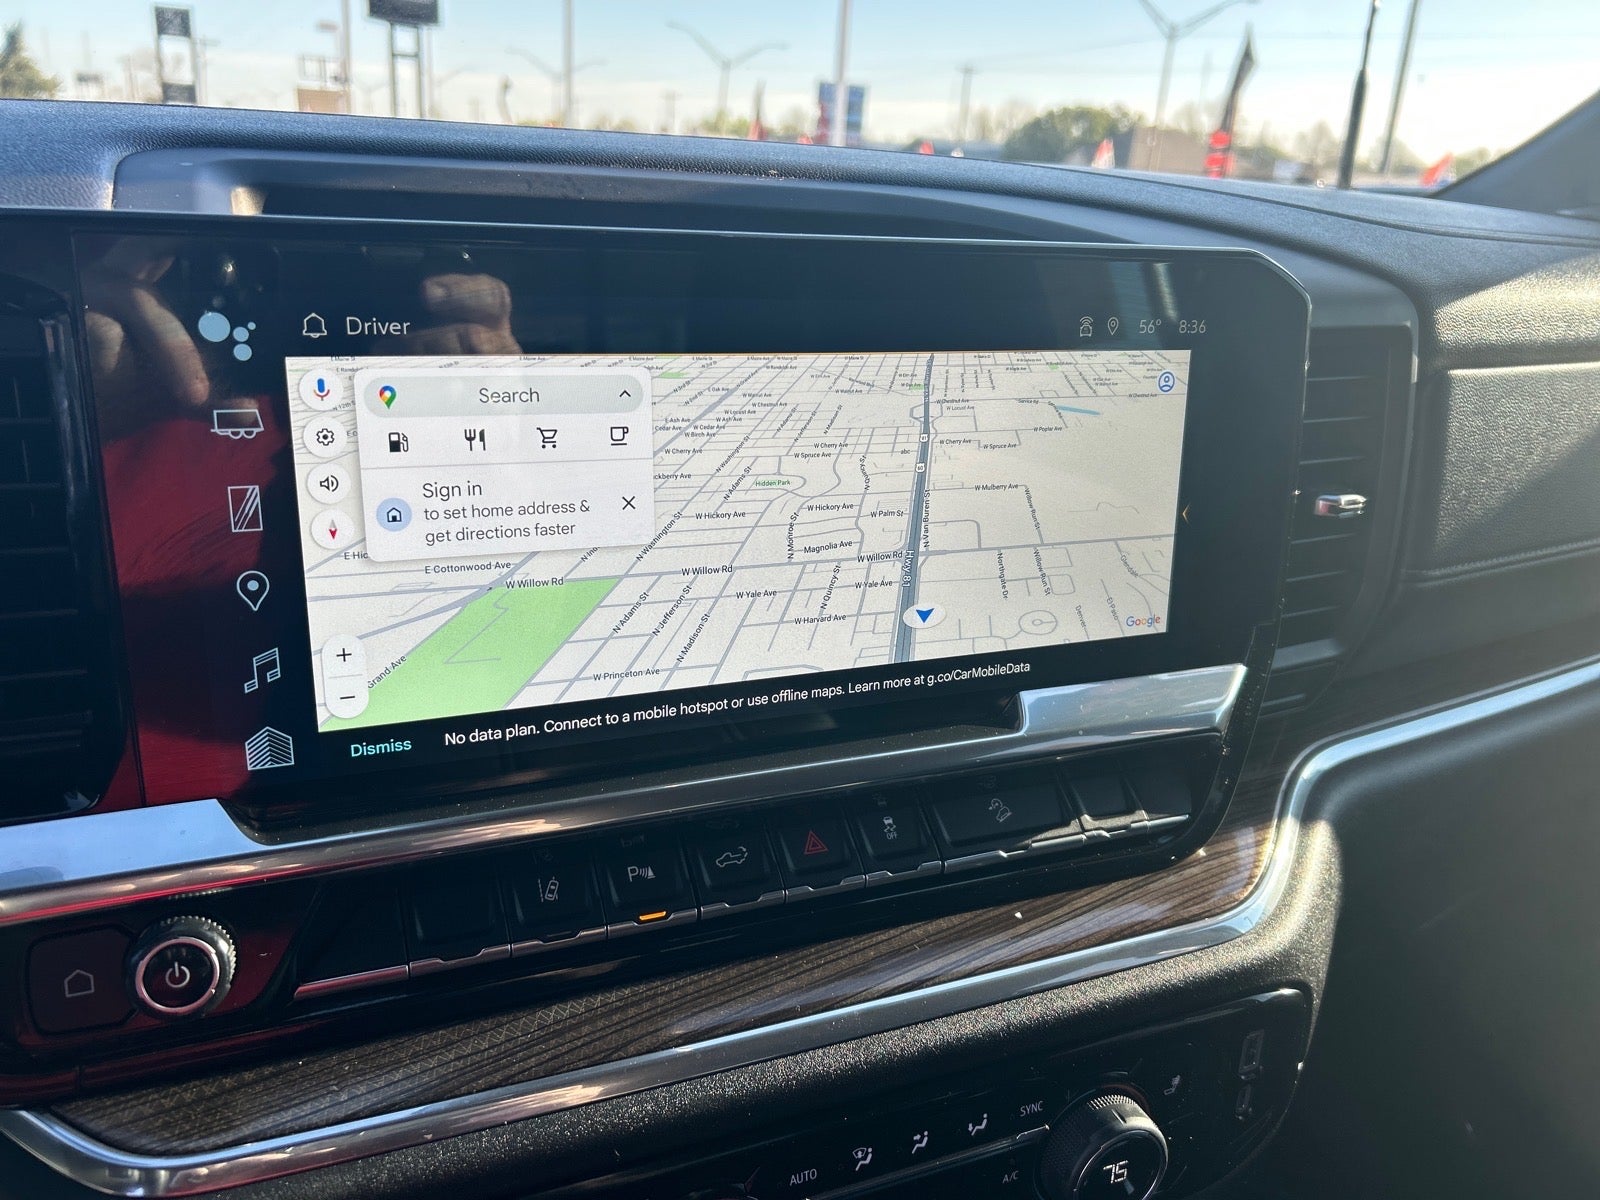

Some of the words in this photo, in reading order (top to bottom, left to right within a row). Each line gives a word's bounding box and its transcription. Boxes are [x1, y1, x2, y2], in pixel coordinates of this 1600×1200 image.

[346, 316, 411, 336] Driver
[1139, 318, 1162, 334] 56°
[1178, 320, 1206, 334] 8:36
[479, 387, 540, 404] Search
[719, 440, 746, 470] Washington
[728, 473, 746, 495] Adams
[744, 466, 752, 475] St
[860, 463, 871, 485] Quincy
[422, 482, 462, 502] Sign
[467, 480, 483, 497] in
[923, 489, 931, 498] St
[424, 507, 440, 521] to
[443, 506, 468, 520] set
[471, 504, 514, 518] home
[518, 501, 576, 516] address
[580, 499, 591, 513] &
[704, 512, 732, 520] Hickory
[815, 503, 841, 511] Hickory
[922, 499, 931, 523] Buren
[1024, 488, 1034, 509] Willow
[1034, 520, 1041, 529] St
[791, 512, 800, 522] St
[425, 529, 452, 547] get
[455, 525, 531, 542] directions
[534, 522, 576, 537] faster
[643, 519, 676, 556] Washington
[673, 511, 683, 521] St
[787, 522, 796, 551] Monroe
[343, 551, 351, 560] E
[803, 542, 839, 553] Magnolia
[839, 540, 853, 548] Ave
[857, 555, 865, 563] W
[866, 553, 892, 562] Willow
[892, 551, 903, 560] Rd
[902, 549, 915, 577] Hwy
[1033, 549, 1044, 573] Willow
[1120, 554, 1139, 578] Glendale
[424, 565, 432, 574] E
[433, 562, 492, 574] Cottonwood
[494, 561, 511, 570] Ave
[681, 567, 690, 576] W
[692, 566, 721, 575] Willow
[721, 564, 733, 573] Rd
[997, 552, 1007, 589] Northgate
[1002, 589, 1009, 599] Dr
[505, 580, 515, 589] W
[517, 578, 547, 588] Willow
[548, 576, 564, 587] Rd
[823, 573, 840, 602] Quincy
[833, 564, 842, 574] St
[901, 575, 912, 588] 81
[1040, 573, 1048, 587] Run
[736, 591, 744, 599] W
[745, 590, 761, 598] Yale
[763, 589, 778, 597] Ave
[1043, 587, 1050, 596] St
[612, 625, 621, 634] N
[619, 599, 643, 627] Adams
[639, 591, 649, 601] St
[652, 627, 661, 636] N
[657, 592, 686, 630] Jefferson
[682, 584, 692, 595] St
[1075, 605, 1087, 628] Denver
[1106, 597, 1113, 607] El
[1110, 604, 1119, 621] Paso
[795, 617, 803, 625] W
[803, 615, 830, 624] Harvard
[832, 613, 846, 622] Ave
[1126, 613, 1161, 628] Google
[676, 653, 685, 663] N
[681, 621, 705, 657] Madison
[701, 613, 711, 623] St
[367, 665, 392, 689] Grand
[390, 655, 407, 672] Ave
[593, 672, 602, 681] W
[603, 669, 643, 679] Princeton
[645, 667, 660, 676] Ave
[444, 732, 466, 746] No
[469, 728, 503, 743] data
[506, 724, 540, 741] plan.
[544, 715, 602, 733] Connect
[605, 713, 619, 725] to
[622, 714, 631, 723] a
[633, 703, 677, 720] mobile
[680, 698, 728, 716] hotspot
[731, 699, 744, 709] or
[747, 694, 769, 707] use
[771, 687, 809, 704] offline
[811, 685, 845, 700] maps.
[848, 681, 880, 694] Learn
[883, 678, 911, 690] more
[913, 674, 925, 686] at
[926, 661, 1031, 687] g.co/CarMobileData
[350, 739, 412, 757] Dismiss
[886, 830, 898, 840] OFF
[1019, 1100, 1044, 1118] SYNC
[789, 1168, 818, 1187] AUTO
[1002, 1170, 1019, 1184] A/C
[1102, 1159, 1129, 1184] 75
